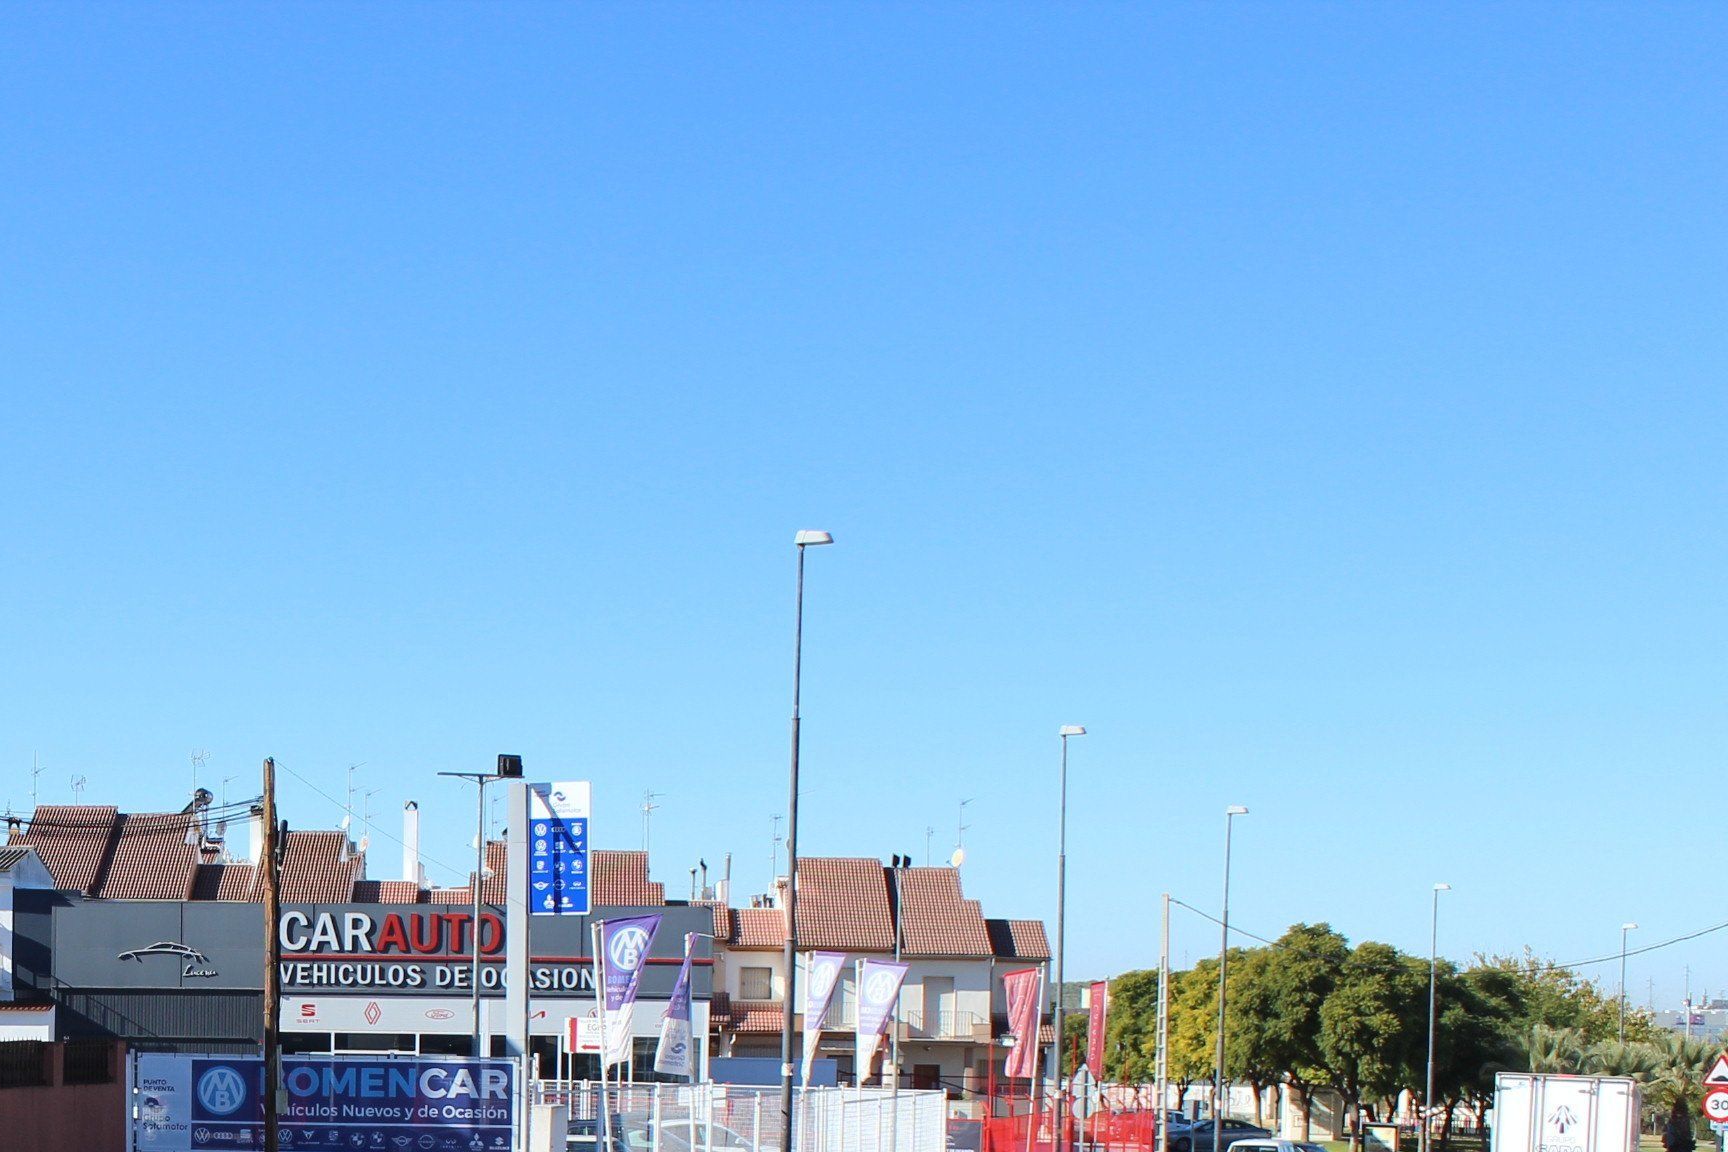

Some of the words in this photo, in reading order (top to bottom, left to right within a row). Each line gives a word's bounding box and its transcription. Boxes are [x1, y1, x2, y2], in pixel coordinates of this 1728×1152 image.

[279, 910, 503, 954] CARAUTO
[280, 963, 422, 986] VEHICULOS
[435, 965, 468, 987] DE
[481, 967, 596, 989] OSION
[260, 1103, 338, 1117] ículos
[343, 1105, 401, 1117] Nuevos
[405, 1107, 414, 1120] y
[418, 1106, 438, 1118] de
[442, 1105, 508, 1119] Ocasión
[1711, 1100, 1728, 1110] 30
